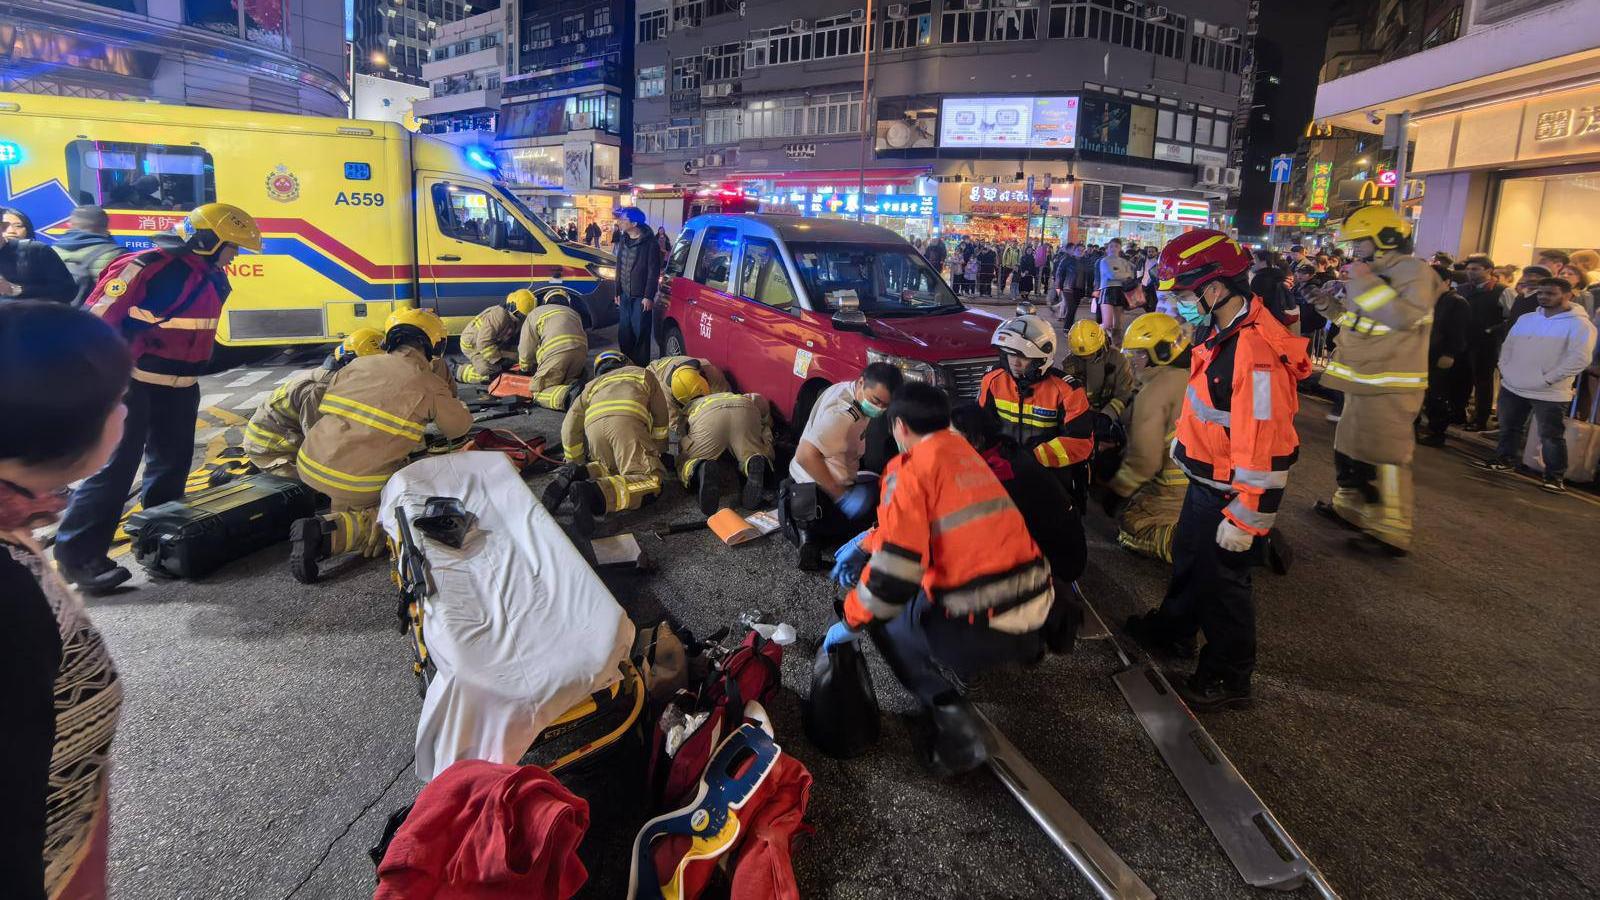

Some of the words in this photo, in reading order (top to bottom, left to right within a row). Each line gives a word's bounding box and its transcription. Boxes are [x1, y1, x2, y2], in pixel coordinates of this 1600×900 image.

[335, 192, 385, 206] A559
[700, 312, 713, 323] 的士
[699, 323, 712, 339] TAXI
